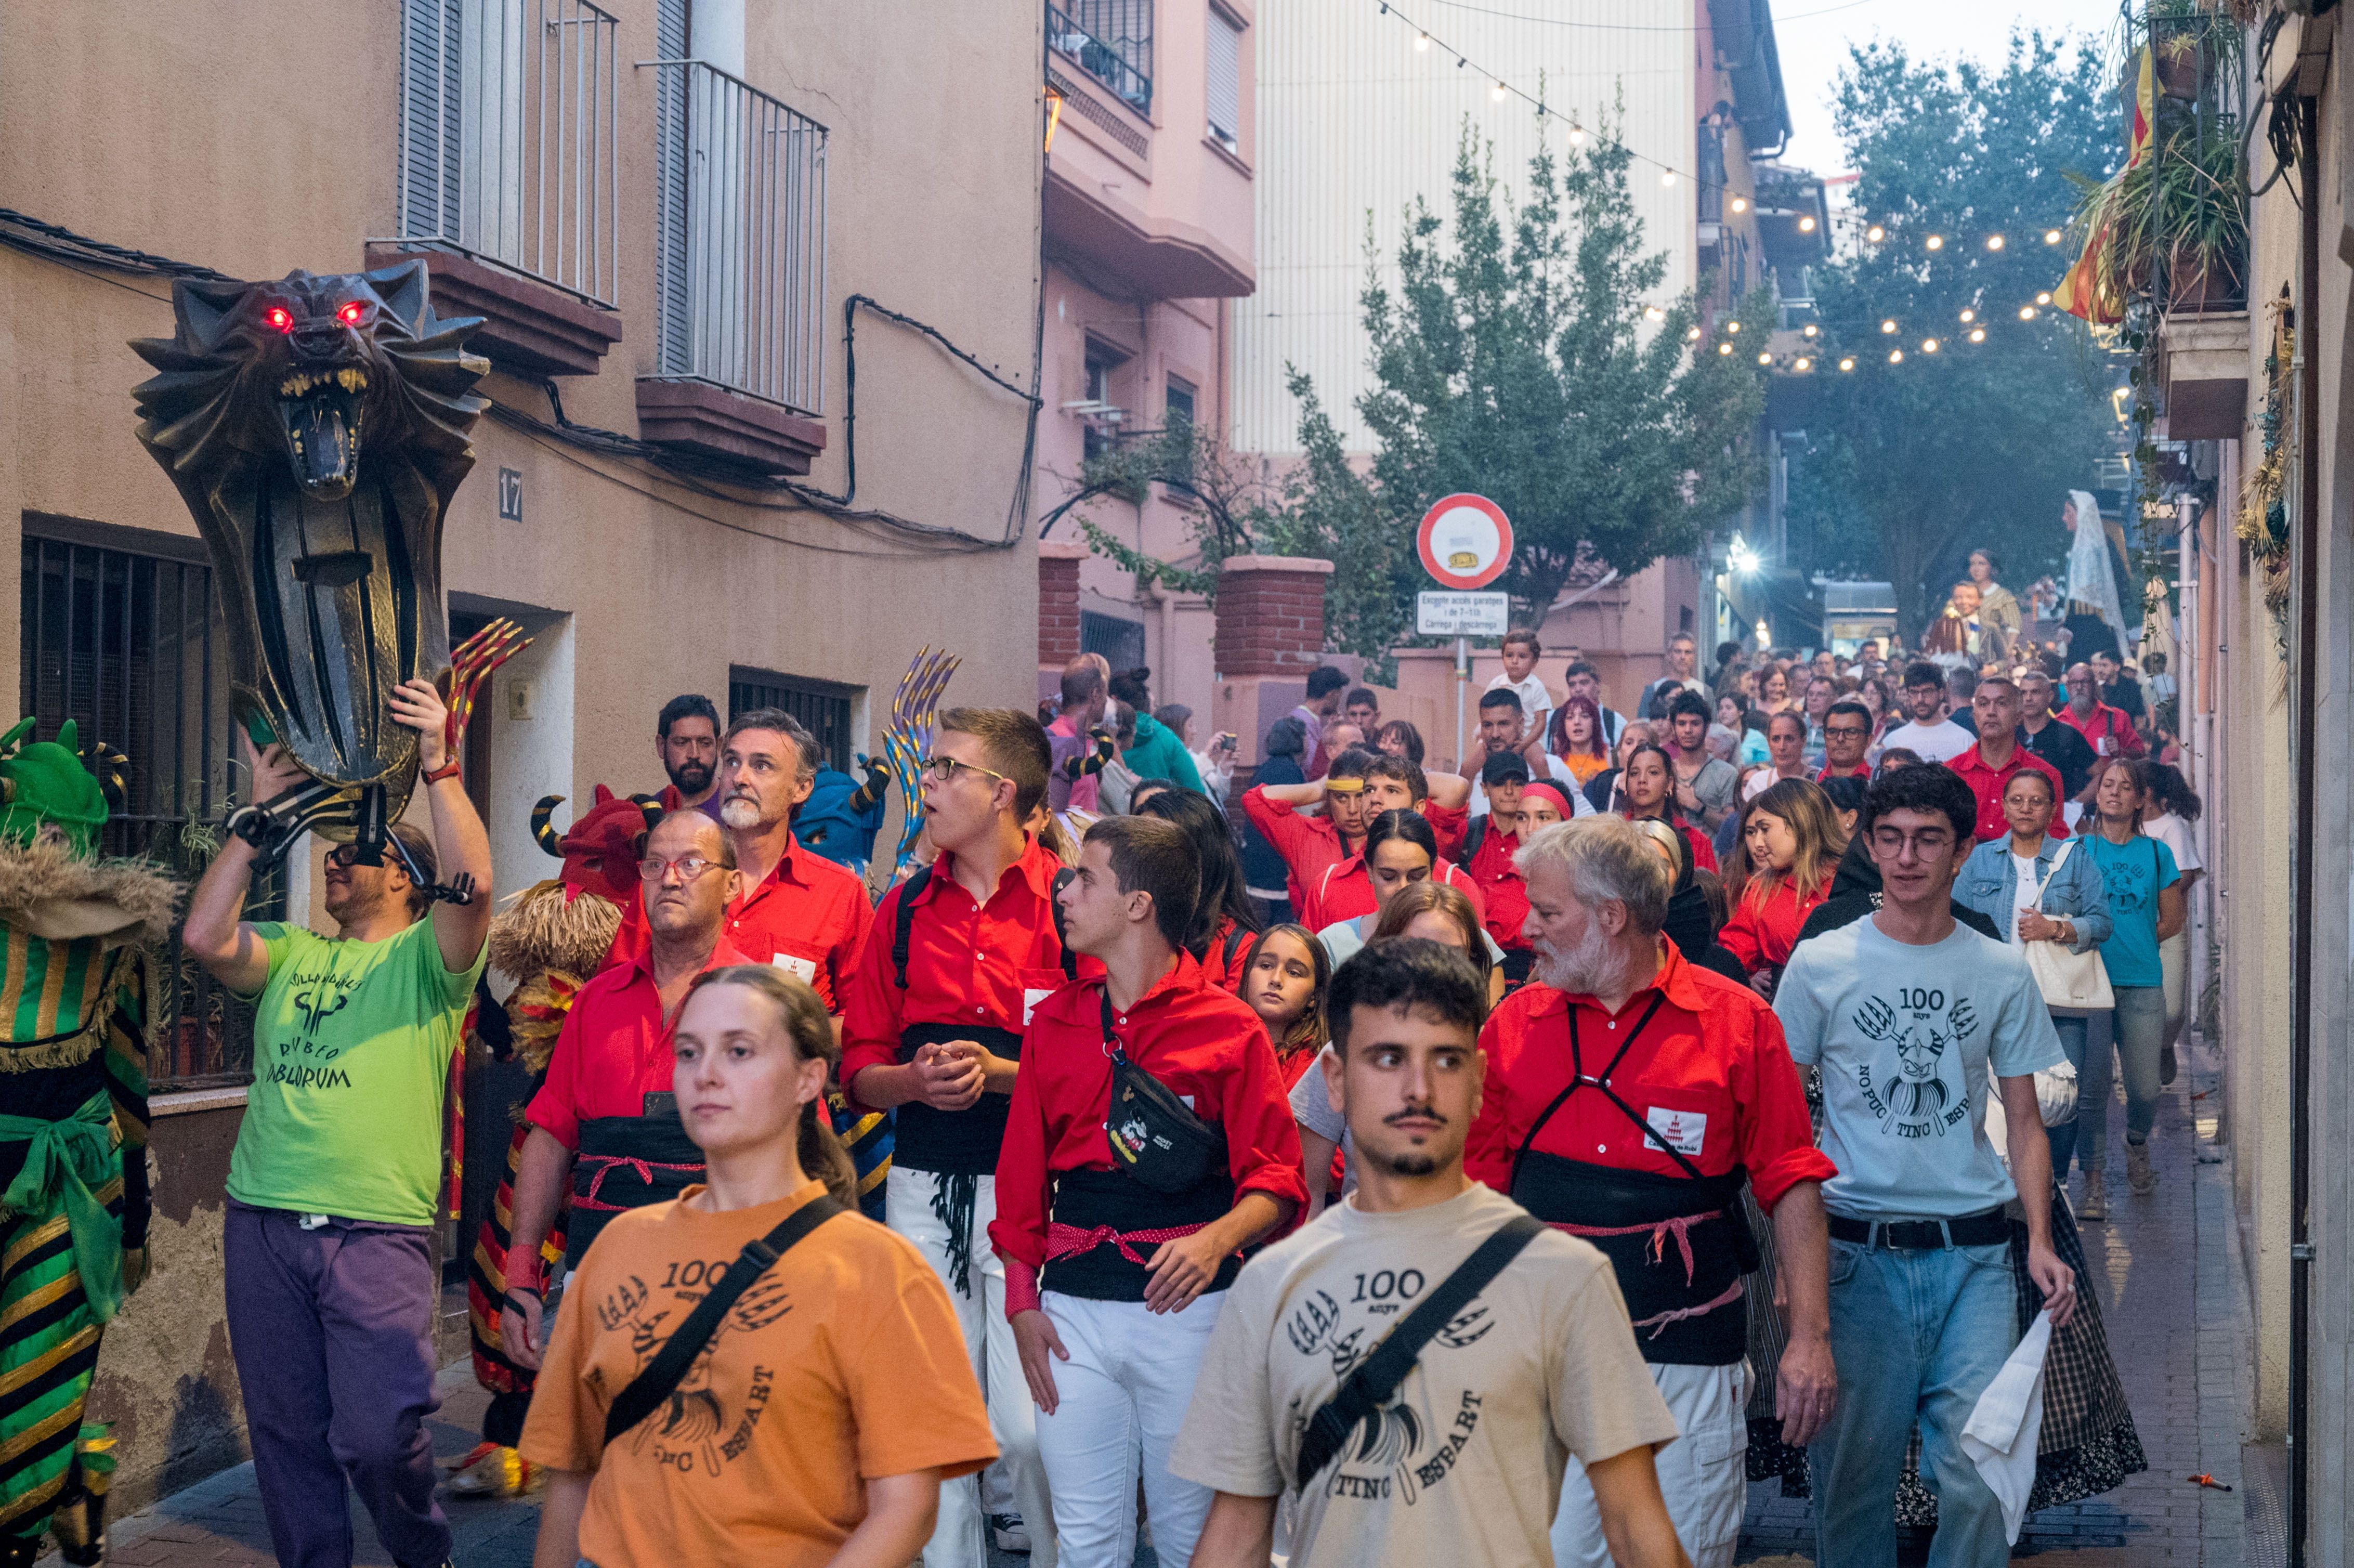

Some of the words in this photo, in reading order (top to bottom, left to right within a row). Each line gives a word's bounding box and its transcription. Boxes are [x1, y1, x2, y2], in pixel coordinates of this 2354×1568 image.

[501, 474, 520, 516] 17
[1900, 988, 1944, 1011] 100
[1859, 1064, 1871, 1088] NO
[1862, 1088, 1888, 1119] PUC
[1897, 1122, 1931, 1139] TINC
[660, 1260, 730, 1289] 100
[1351, 1269, 1426, 1303] 100
[1368, 1303, 1400, 1315] anys
[1415, 1390, 1483, 1489] ESPART
